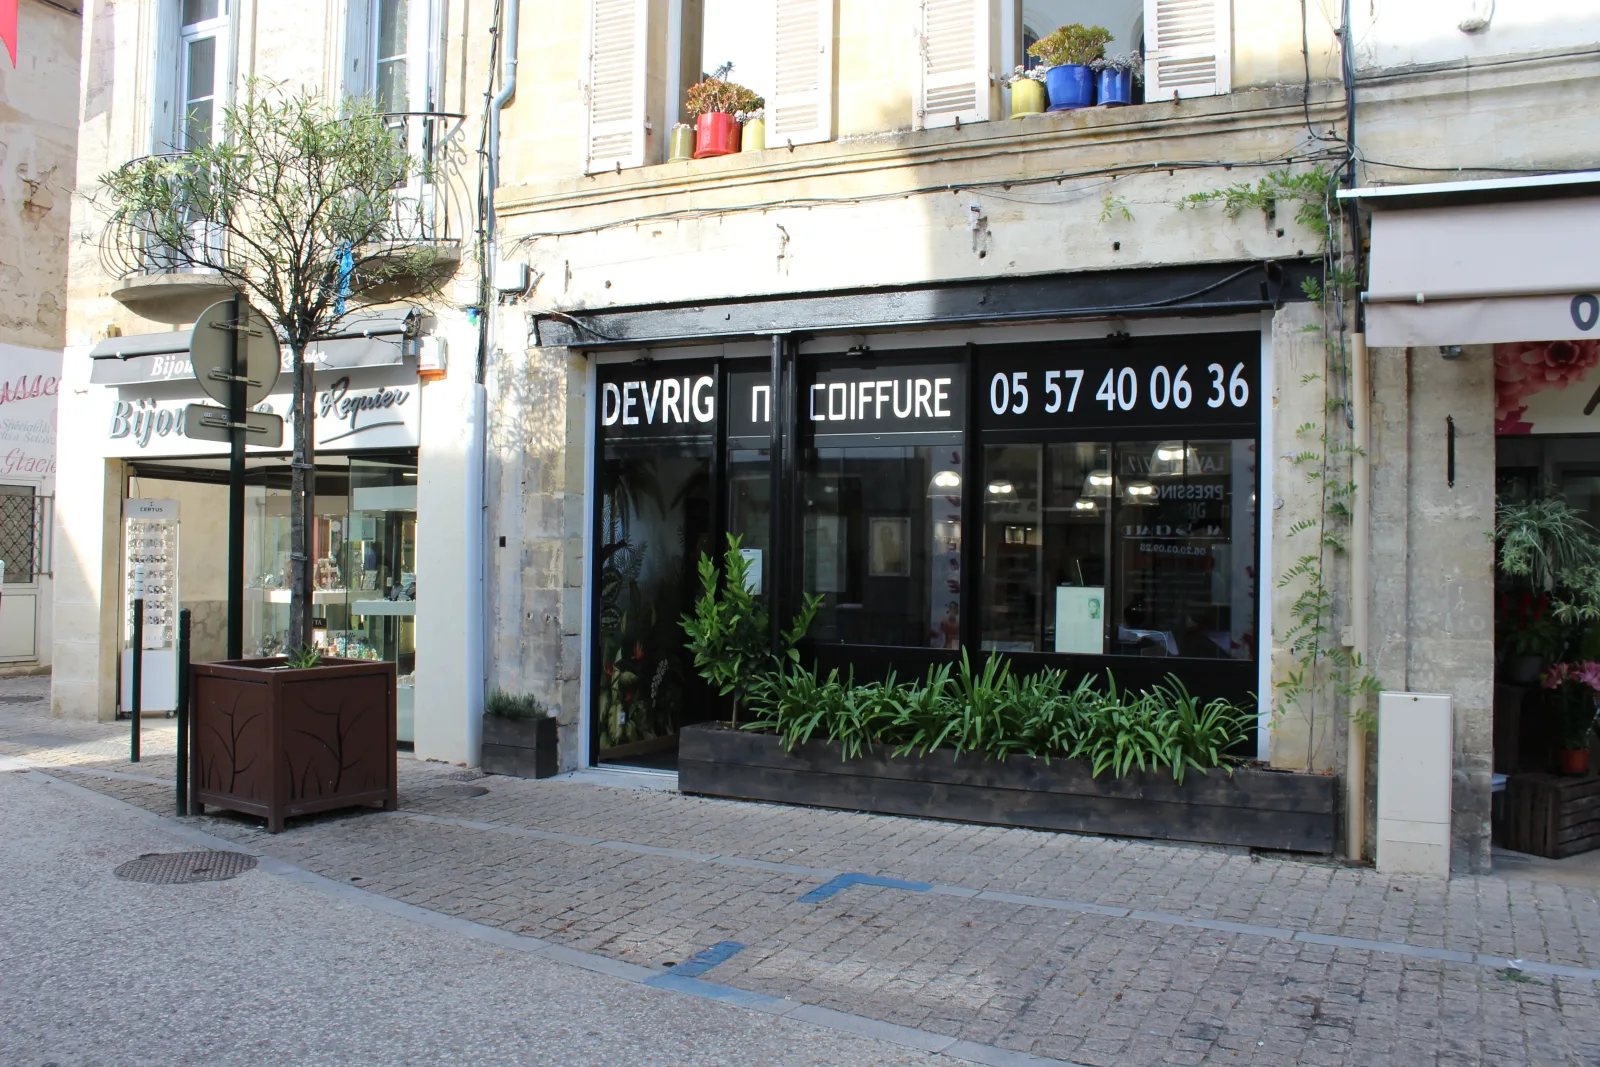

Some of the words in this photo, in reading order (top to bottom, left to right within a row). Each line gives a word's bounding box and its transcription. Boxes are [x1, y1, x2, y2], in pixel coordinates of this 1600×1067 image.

[319, 376, 409, 429] Requier
[602, 376, 714, 426] DEVRIG
[810, 378, 951, 421] COIFFURE
[990, 372, 1029, 415] 05
[1044, 369, 1084, 414] 57
[1095, 367, 1138, 411] 40
[1150, 364, 1192, 410] 06
[1207, 361, 1249, 408] 36
